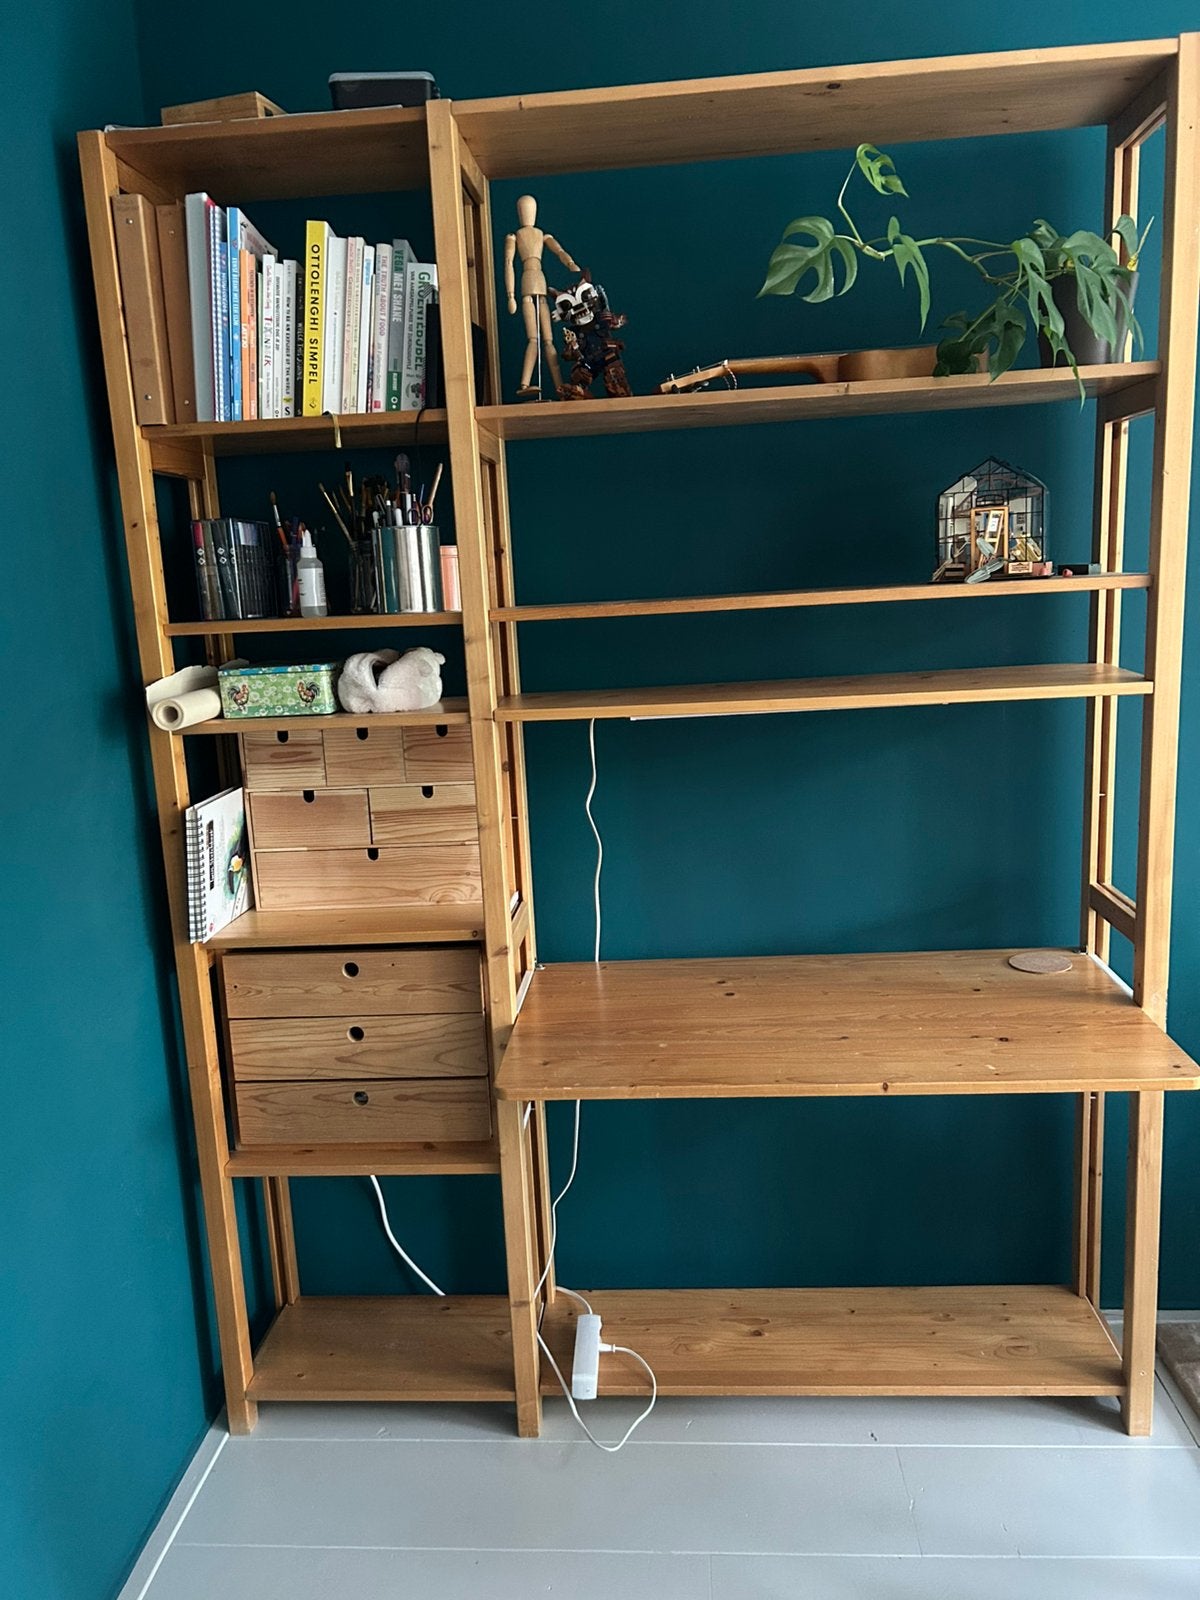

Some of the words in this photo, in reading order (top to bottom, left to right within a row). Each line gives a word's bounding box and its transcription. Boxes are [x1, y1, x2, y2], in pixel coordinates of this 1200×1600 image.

[394, 249, 403, 272] VEGA
[310, 244, 320, 330] OTTOLENGHI
[393, 273, 403, 292] MET
[392, 293, 402, 322] SHANE
[309, 339, 318, 384] SIMPEL
